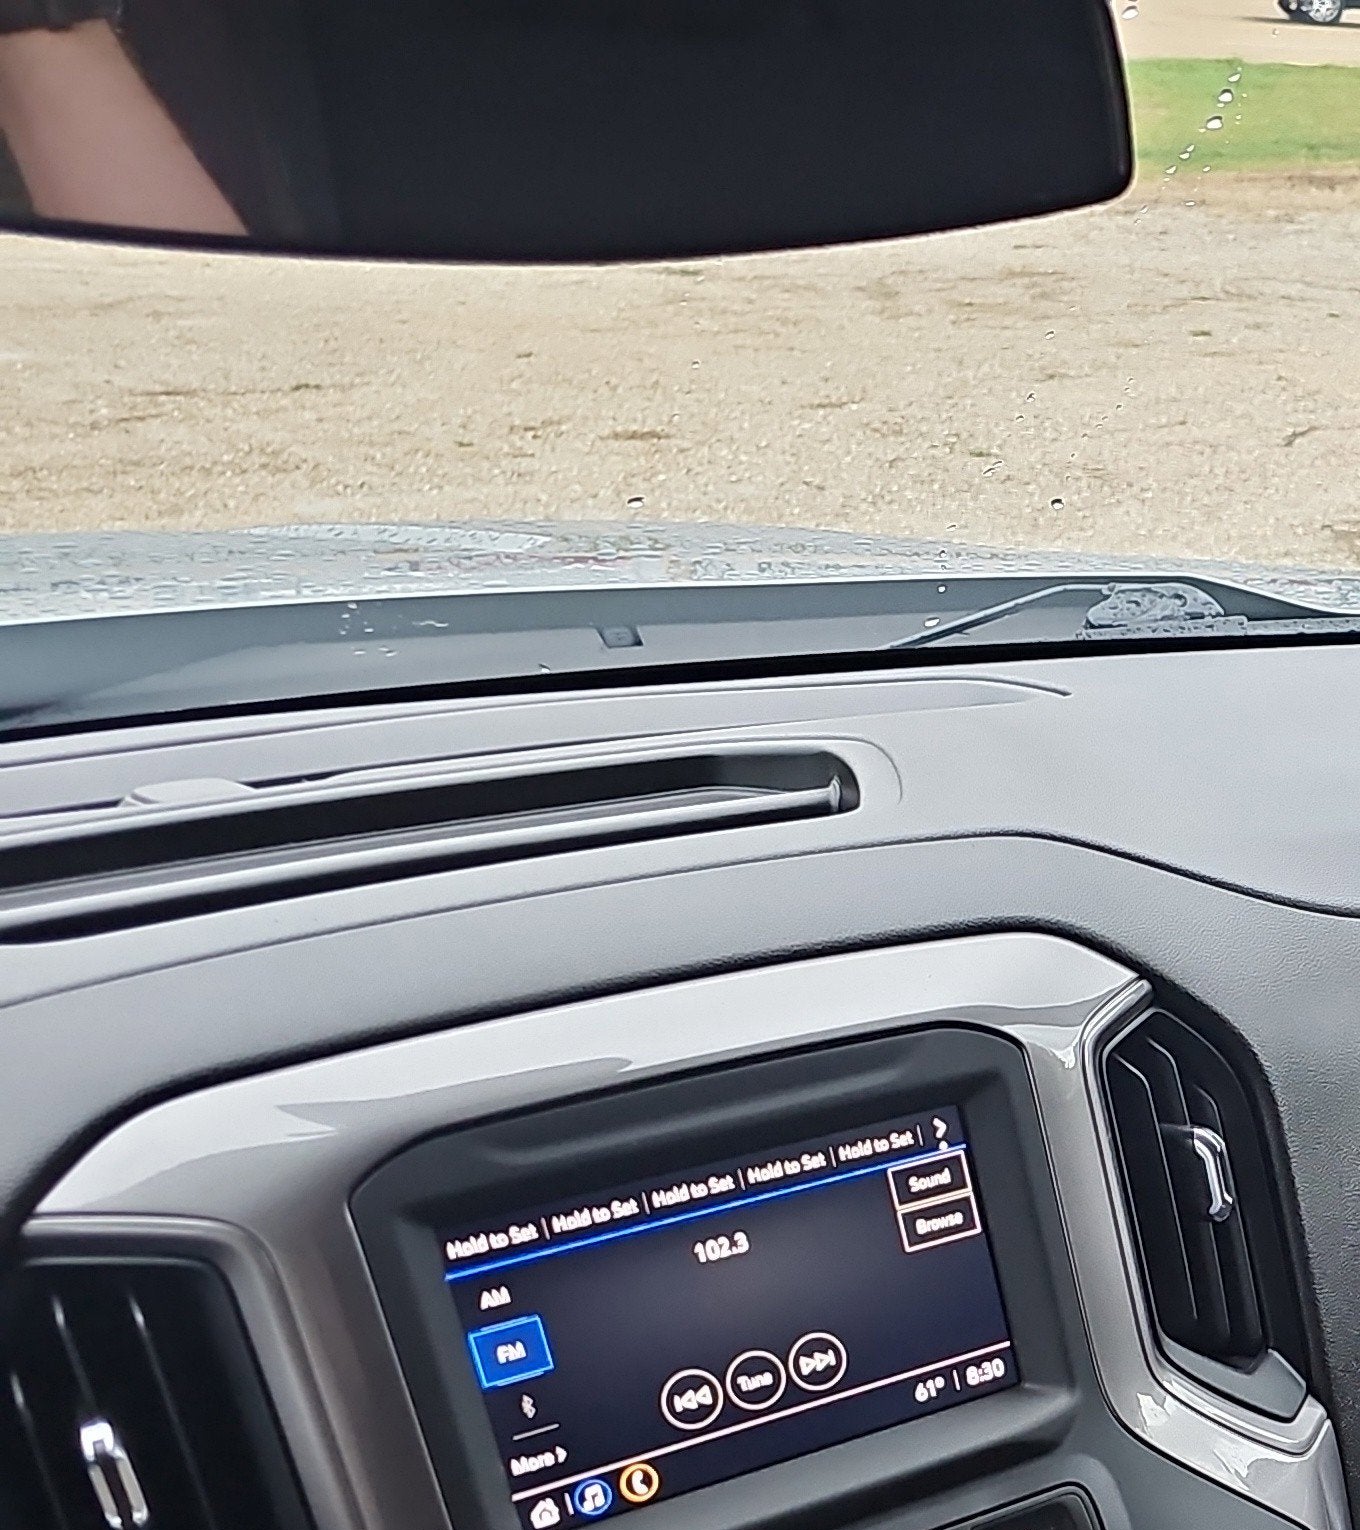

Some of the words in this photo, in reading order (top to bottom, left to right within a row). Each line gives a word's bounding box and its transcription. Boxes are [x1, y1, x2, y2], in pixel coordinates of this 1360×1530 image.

[840, 1141, 873, 1161] Hold
[874, 1139, 890, 1153] to
[891, 1130, 915, 1149] Set
[748, 1161, 783, 1183] Hold
[783, 1160, 801, 1175] to
[802, 1152, 827, 1171] Set
[909, 1168, 951, 1192] Sound
[652, 1183, 690, 1208] Hold
[690, 1182, 708, 1198] to
[708, 1175, 735, 1194] Set
[551, 1207, 592, 1233] Hold
[592, 1206, 611, 1223] to
[611, 1198, 640, 1219] Set
[916, 1211, 964, 1235] Browse
[446, 1233, 489, 1260] Hold
[489, 1232, 510, 1249] to
[508, 1223, 539, 1245] Set
[693, 1232, 749, 1263] 102.3
[480, 1286, 511, 1310] AM
[497, 1341, 526, 1364] FM
[737, 1371, 773, 1392] Tune
[965, 1358, 1005, 1386] 8:30
[510, 1451, 555, 1477] More
